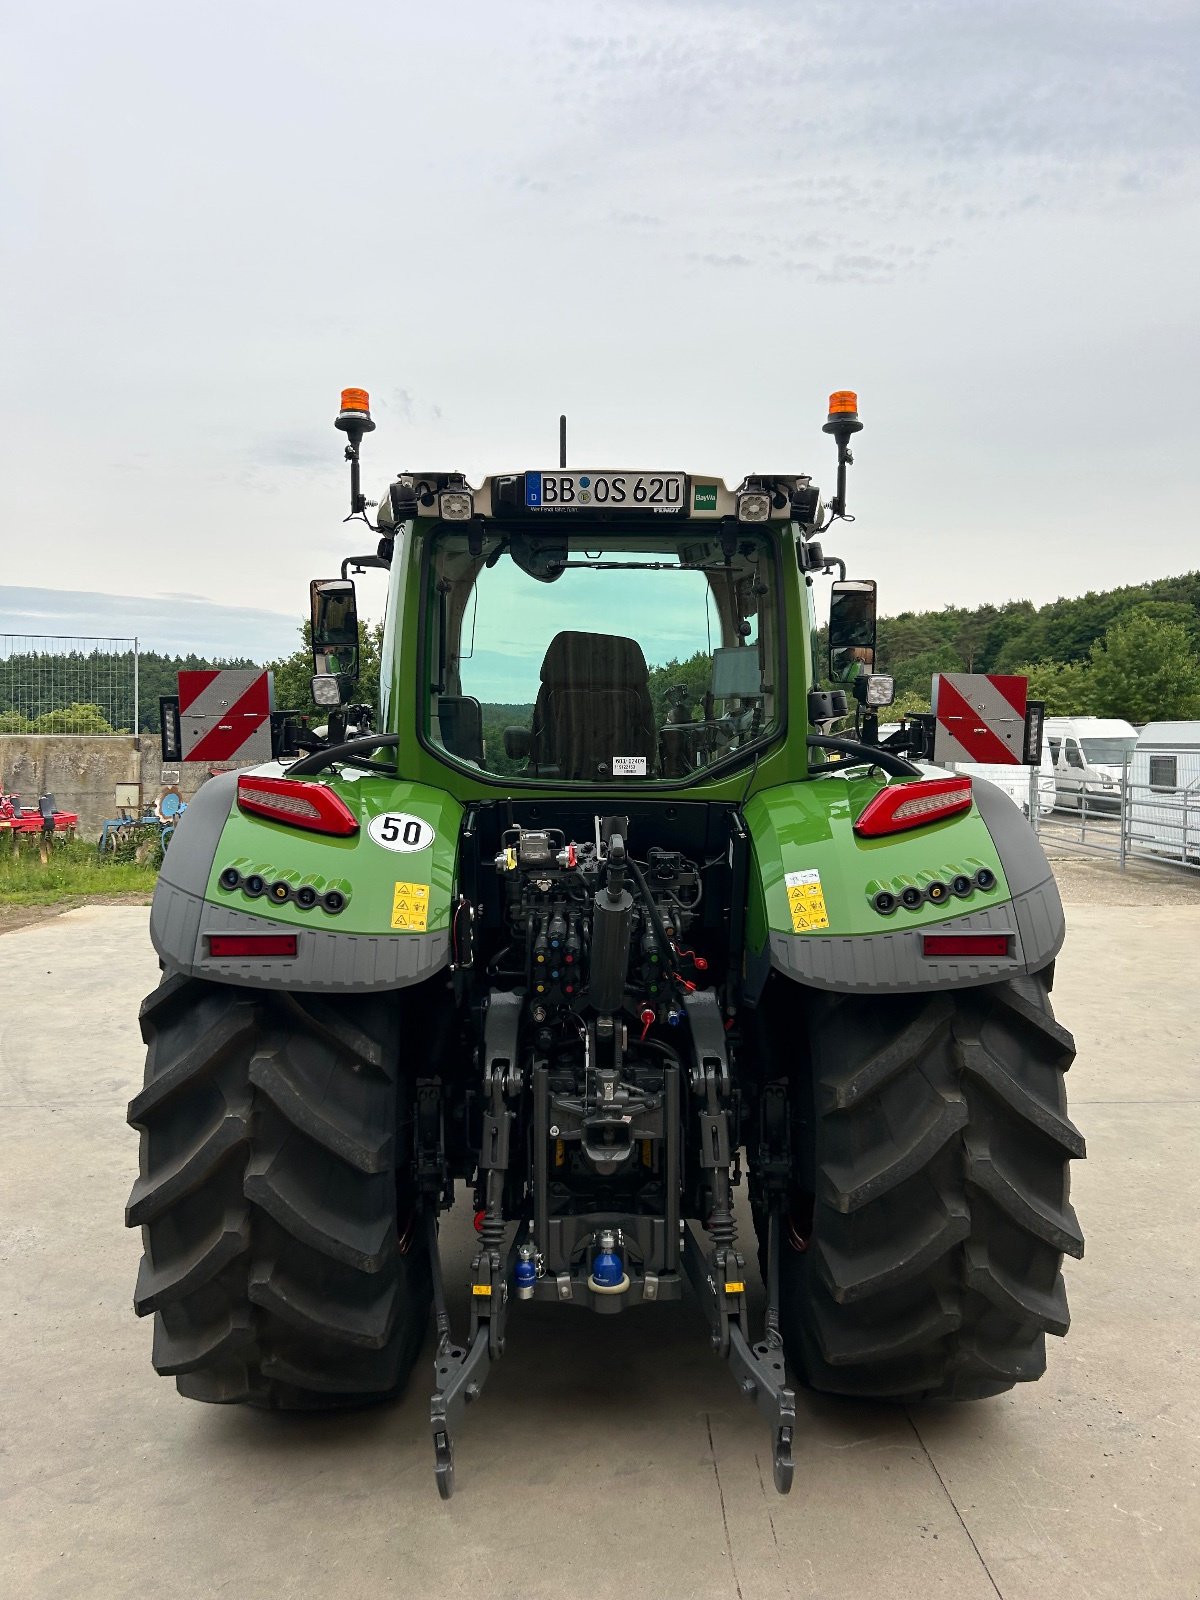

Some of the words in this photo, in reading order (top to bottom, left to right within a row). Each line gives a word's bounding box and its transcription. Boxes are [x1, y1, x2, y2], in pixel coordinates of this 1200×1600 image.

[531, 493, 537, 501] D
[543, 477, 575, 502] BB
[594, 477, 626, 502] OS
[634, 477, 680, 503] 620
[695, 494, 716, 502] BayWa
[381, 817, 422, 845] 50
